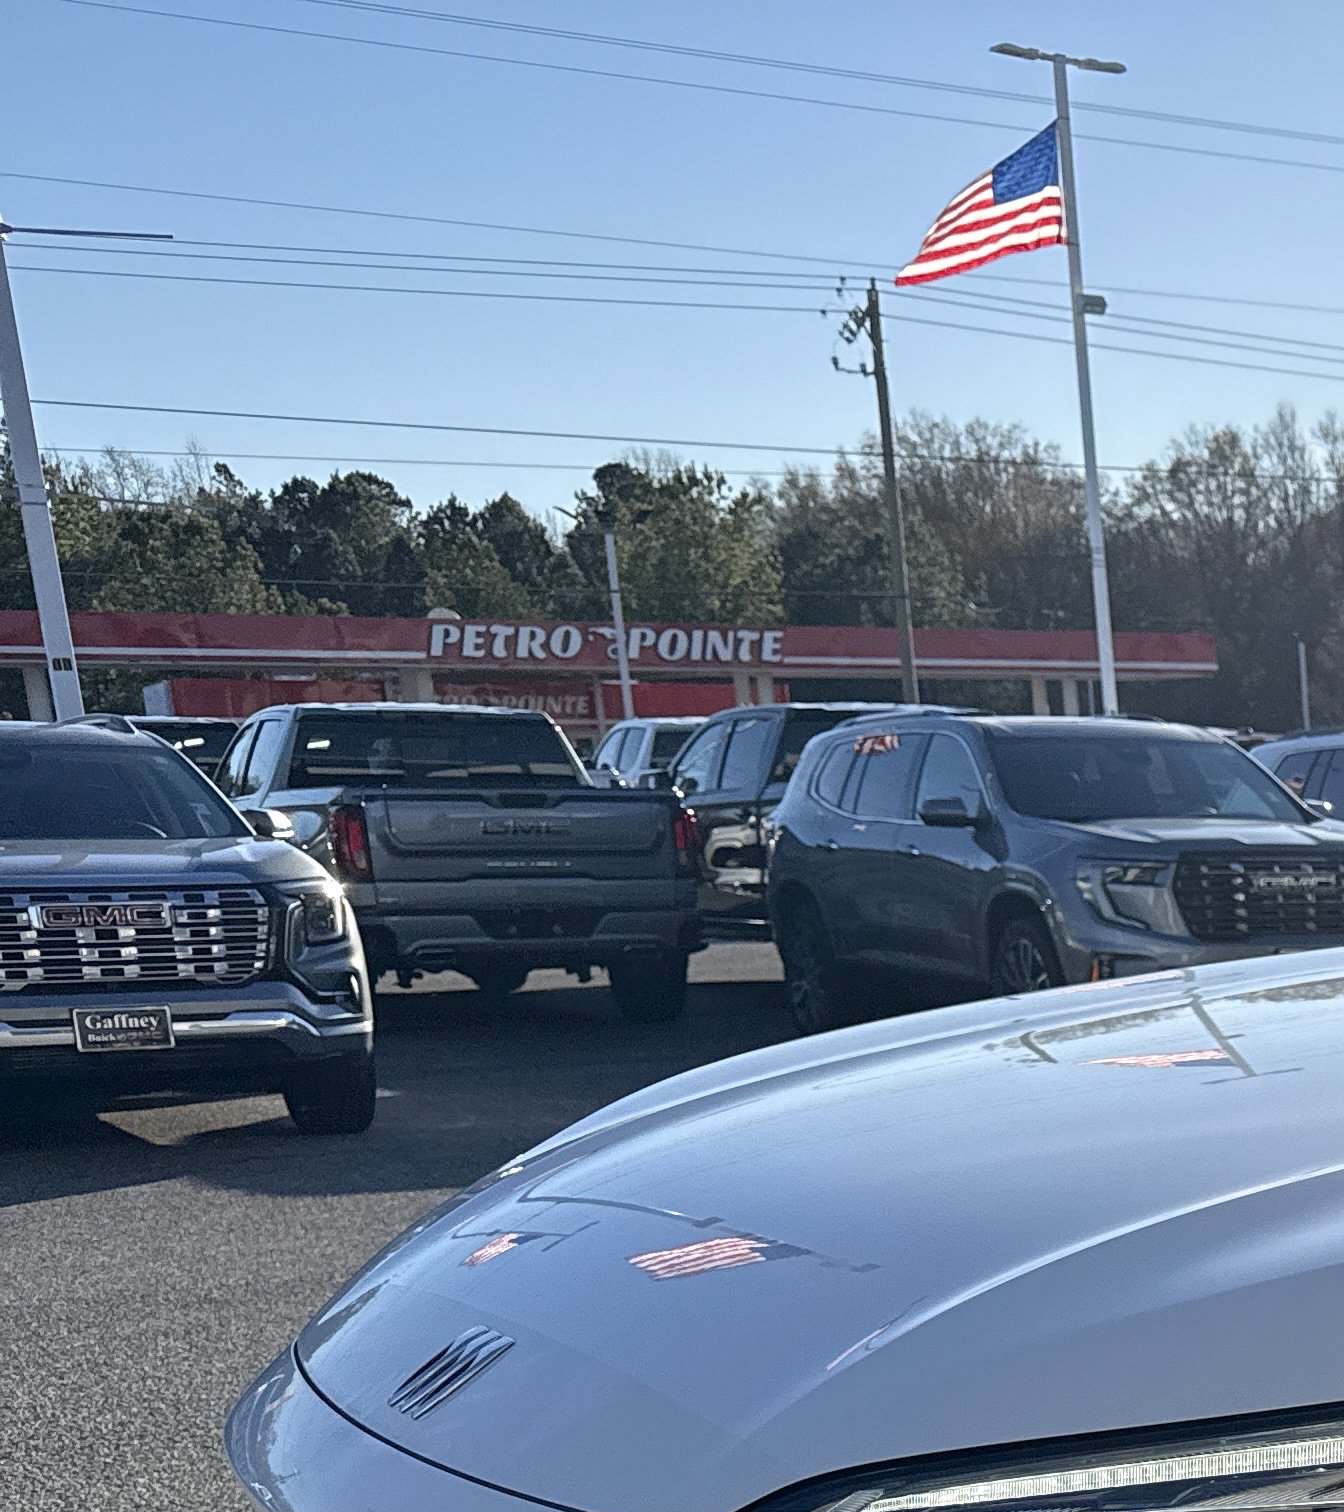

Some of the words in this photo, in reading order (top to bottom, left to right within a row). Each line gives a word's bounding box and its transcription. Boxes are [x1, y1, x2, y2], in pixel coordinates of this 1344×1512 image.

[430, 623, 584, 659] PETRO
[627, 626, 785, 663] POINTE
[42, 904, 167, 928] GMC
[85, 1013, 160, 1031] Gaffney
